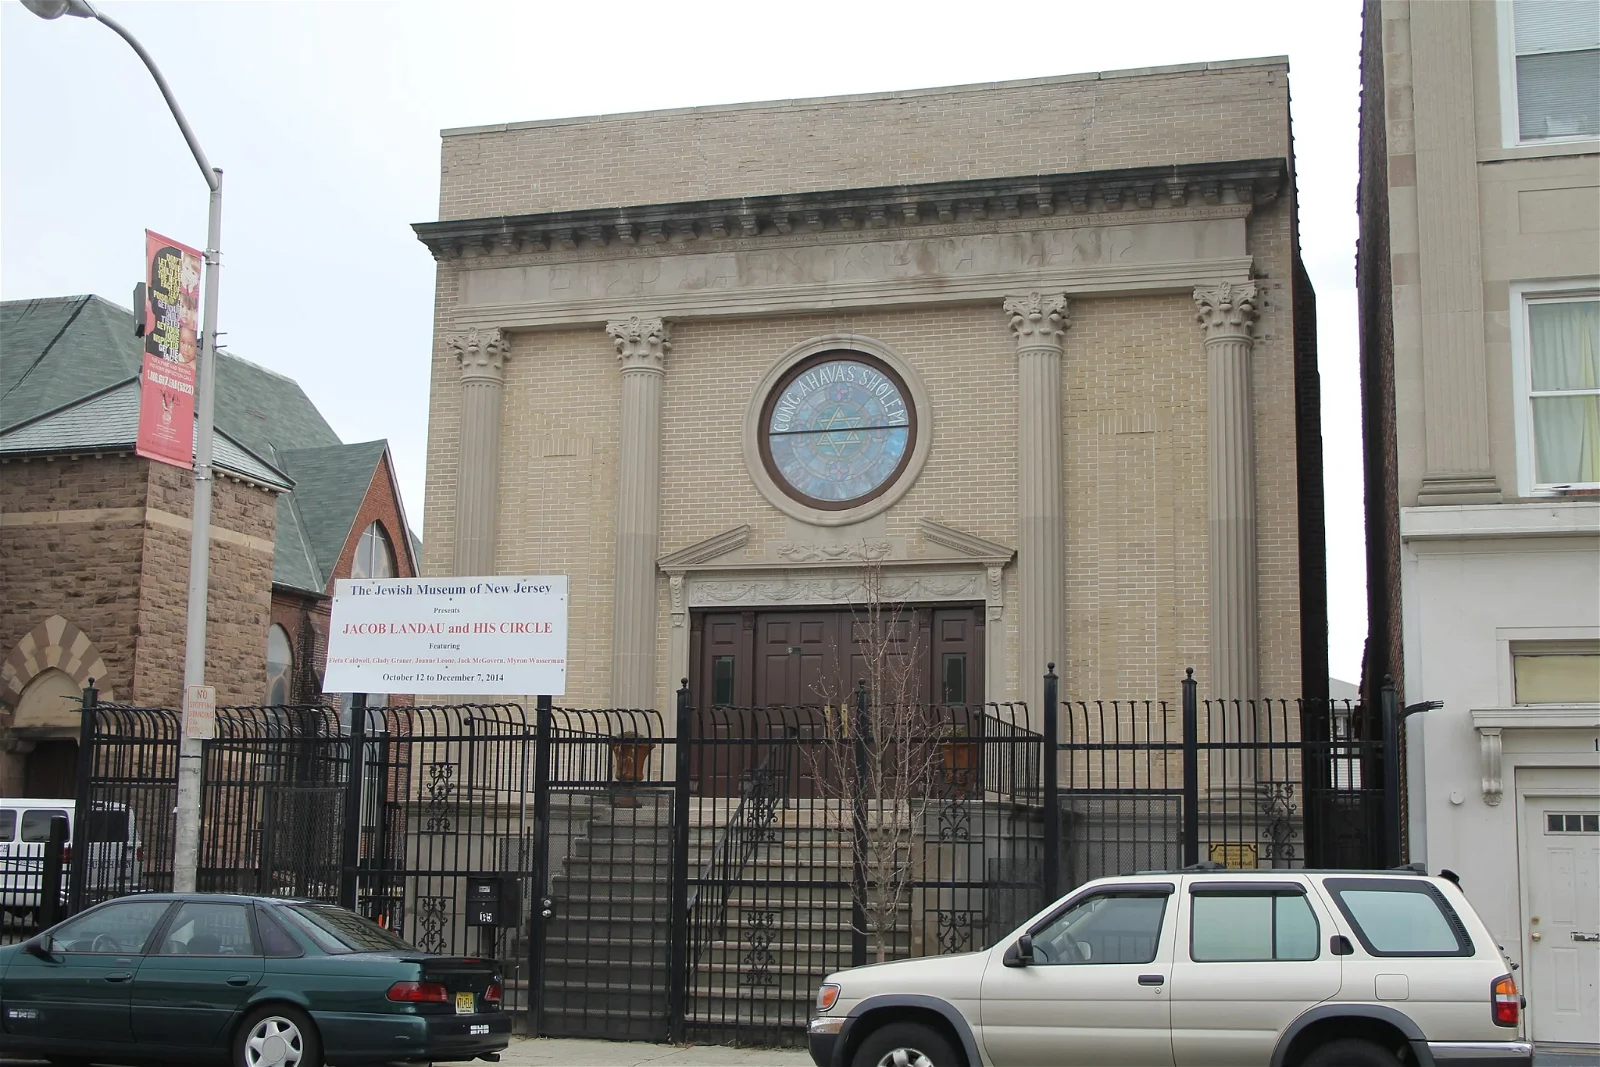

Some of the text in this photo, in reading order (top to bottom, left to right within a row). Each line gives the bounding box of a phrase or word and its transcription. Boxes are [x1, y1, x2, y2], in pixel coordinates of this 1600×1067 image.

[799, 365, 857, 397] AHAVAS
[858, 369, 906, 426] SHOLEM
[350, 582, 552, 596] The Jewish Museum of New Jersey
[342, 622, 553, 635] JACOB LANDAU and HIS CIRCLE
[429, 642, 461, 651] Featuring
[472, 657, 506, 665] McGovern,
[507, 657, 528, 665] Myron
[382, 673, 504, 683] October 12 to December 7, 2014
[196, 689, 208, 700] NO
